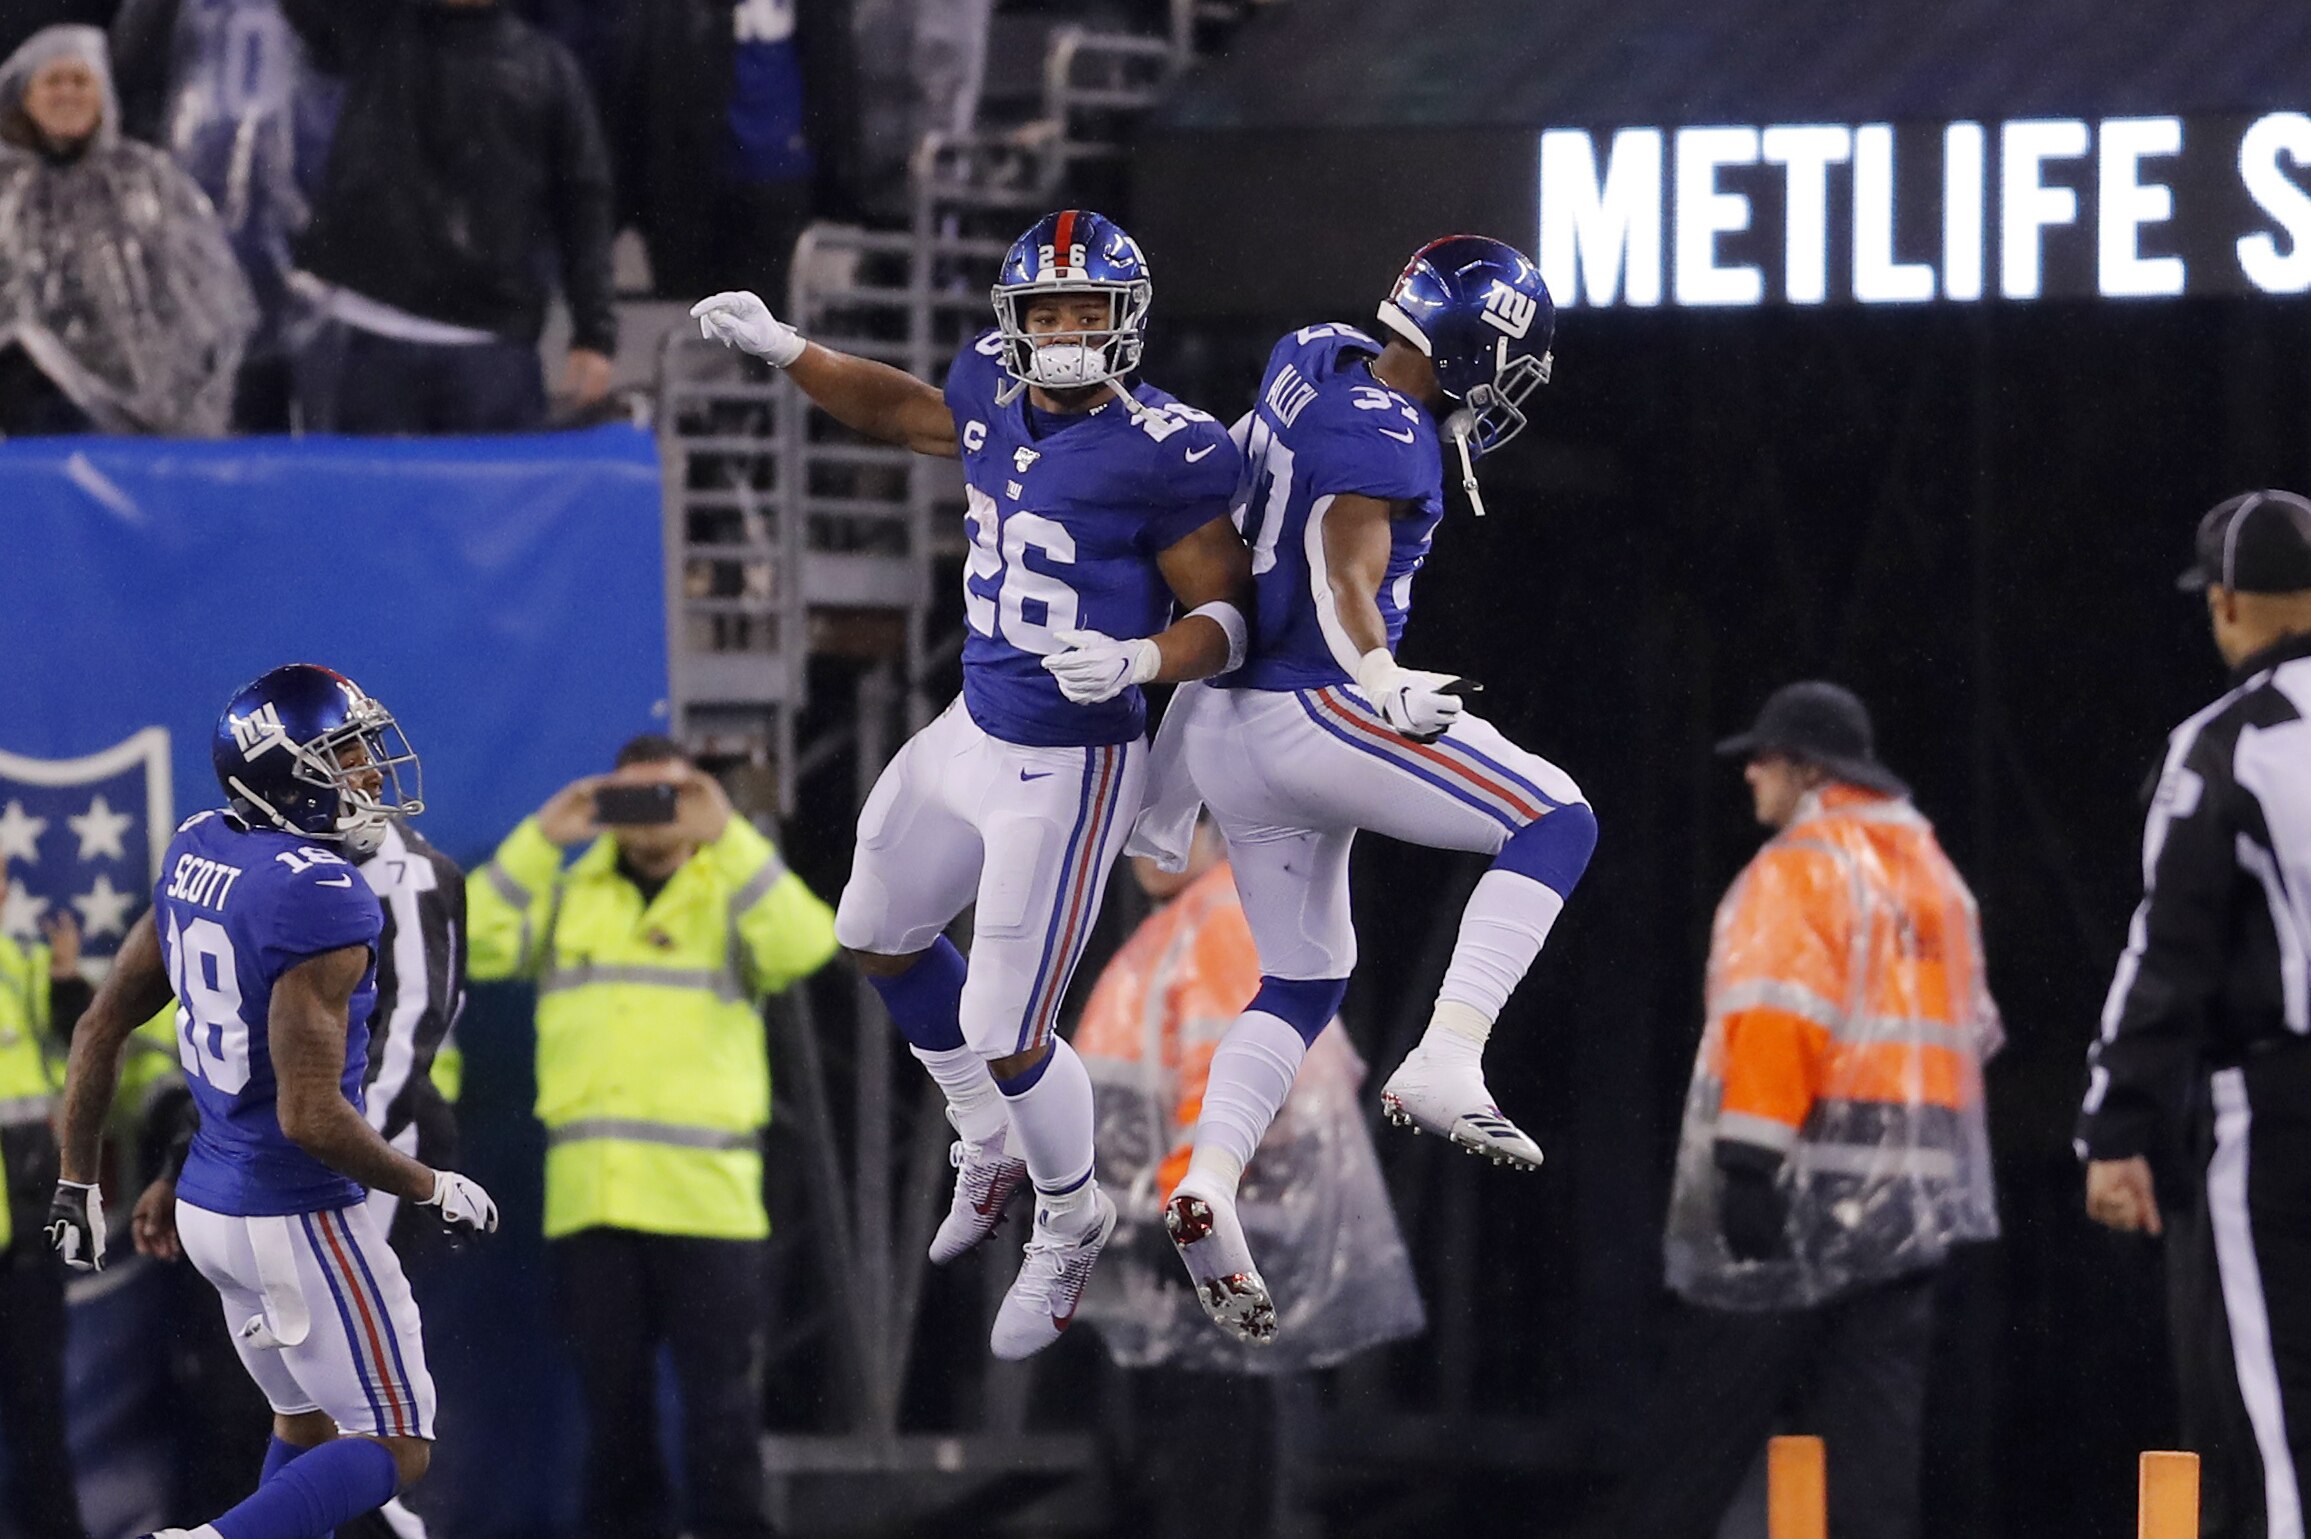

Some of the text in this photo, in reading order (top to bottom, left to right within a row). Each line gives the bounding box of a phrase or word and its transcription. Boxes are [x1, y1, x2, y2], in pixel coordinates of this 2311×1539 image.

[1539, 116, 2187, 308] METLIFE
[1038, 244, 1086, 269] 26
[963, 419, 987, 450] C
[963, 483, 1079, 656] 26
[167, 853, 243, 912] SCOTT
[275, 846, 348, 874] 18
[385, 860, 407, 885] 7
[167, 906, 251, 1096] 18
